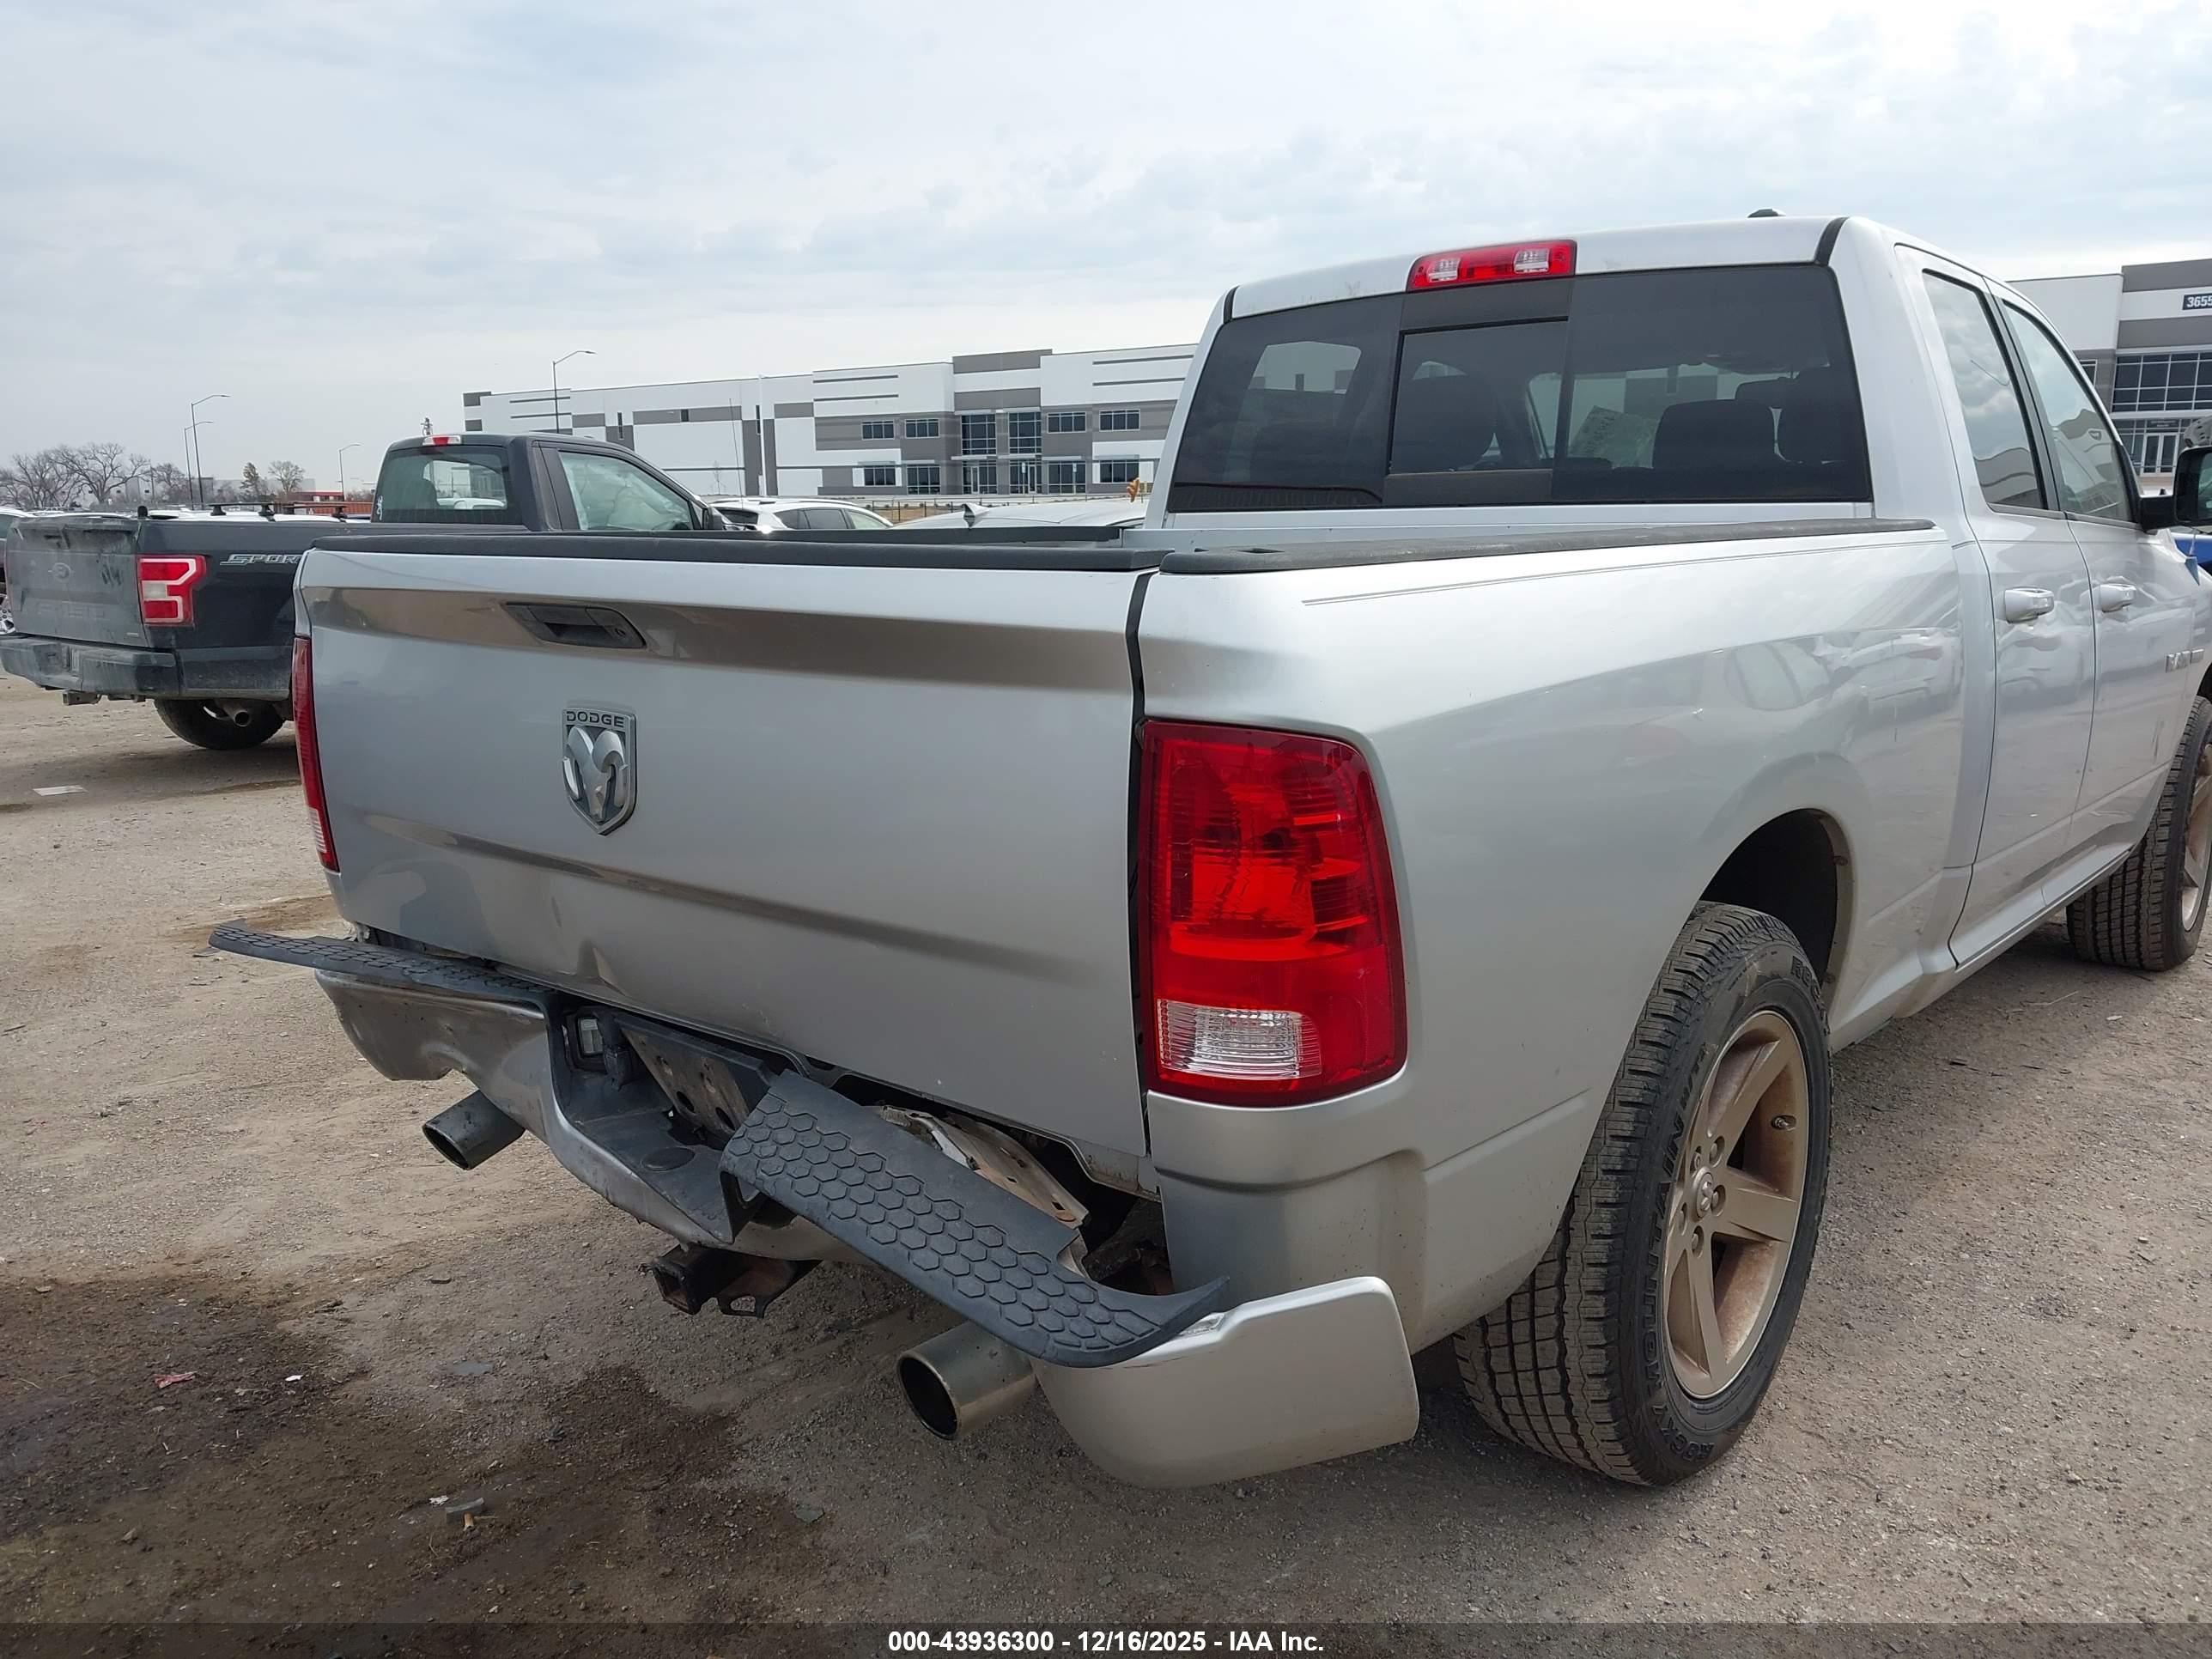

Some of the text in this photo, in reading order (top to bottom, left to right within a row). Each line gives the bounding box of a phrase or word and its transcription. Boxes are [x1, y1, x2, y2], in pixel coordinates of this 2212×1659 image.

[2186, 295, 2212, 307] 3655
[220, 554, 303, 566] SPOR
[566, 710, 624, 728] DODGE
[1651, 1403, 1715, 1459] ROCKY
